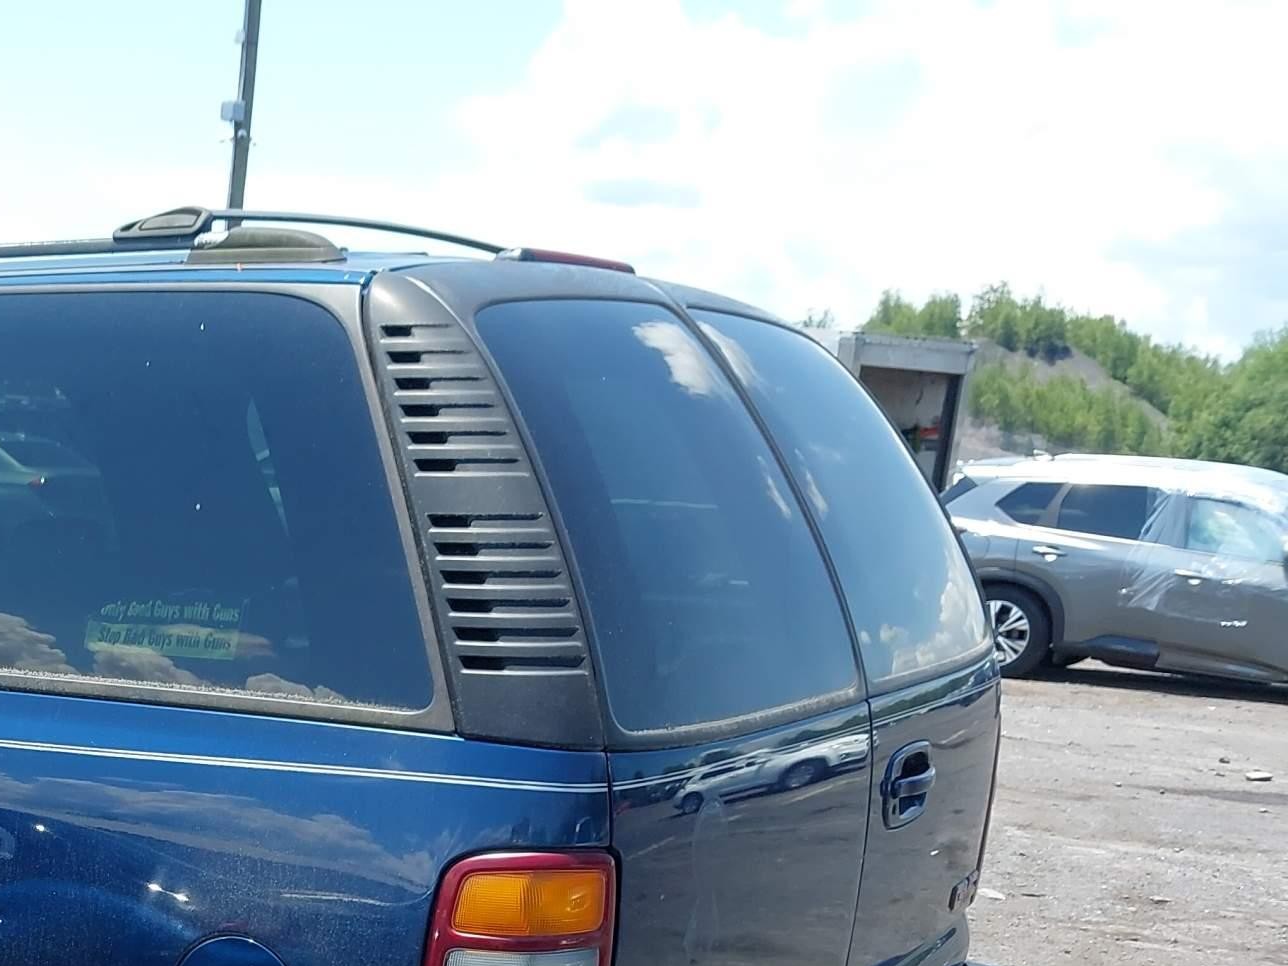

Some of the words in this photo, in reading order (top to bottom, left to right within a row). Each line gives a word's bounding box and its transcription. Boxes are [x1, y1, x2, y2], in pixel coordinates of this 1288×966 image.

[154, 600, 180, 620] Guys
[183, 602, 210, 621] with
[212, 603, 240, 622] Guns
[98, 626, 121, 646] Stop
[148, 629, 172, 648] Guys
[175, 632, 200, 649] with
[204, 632, 231, 650] Guns
